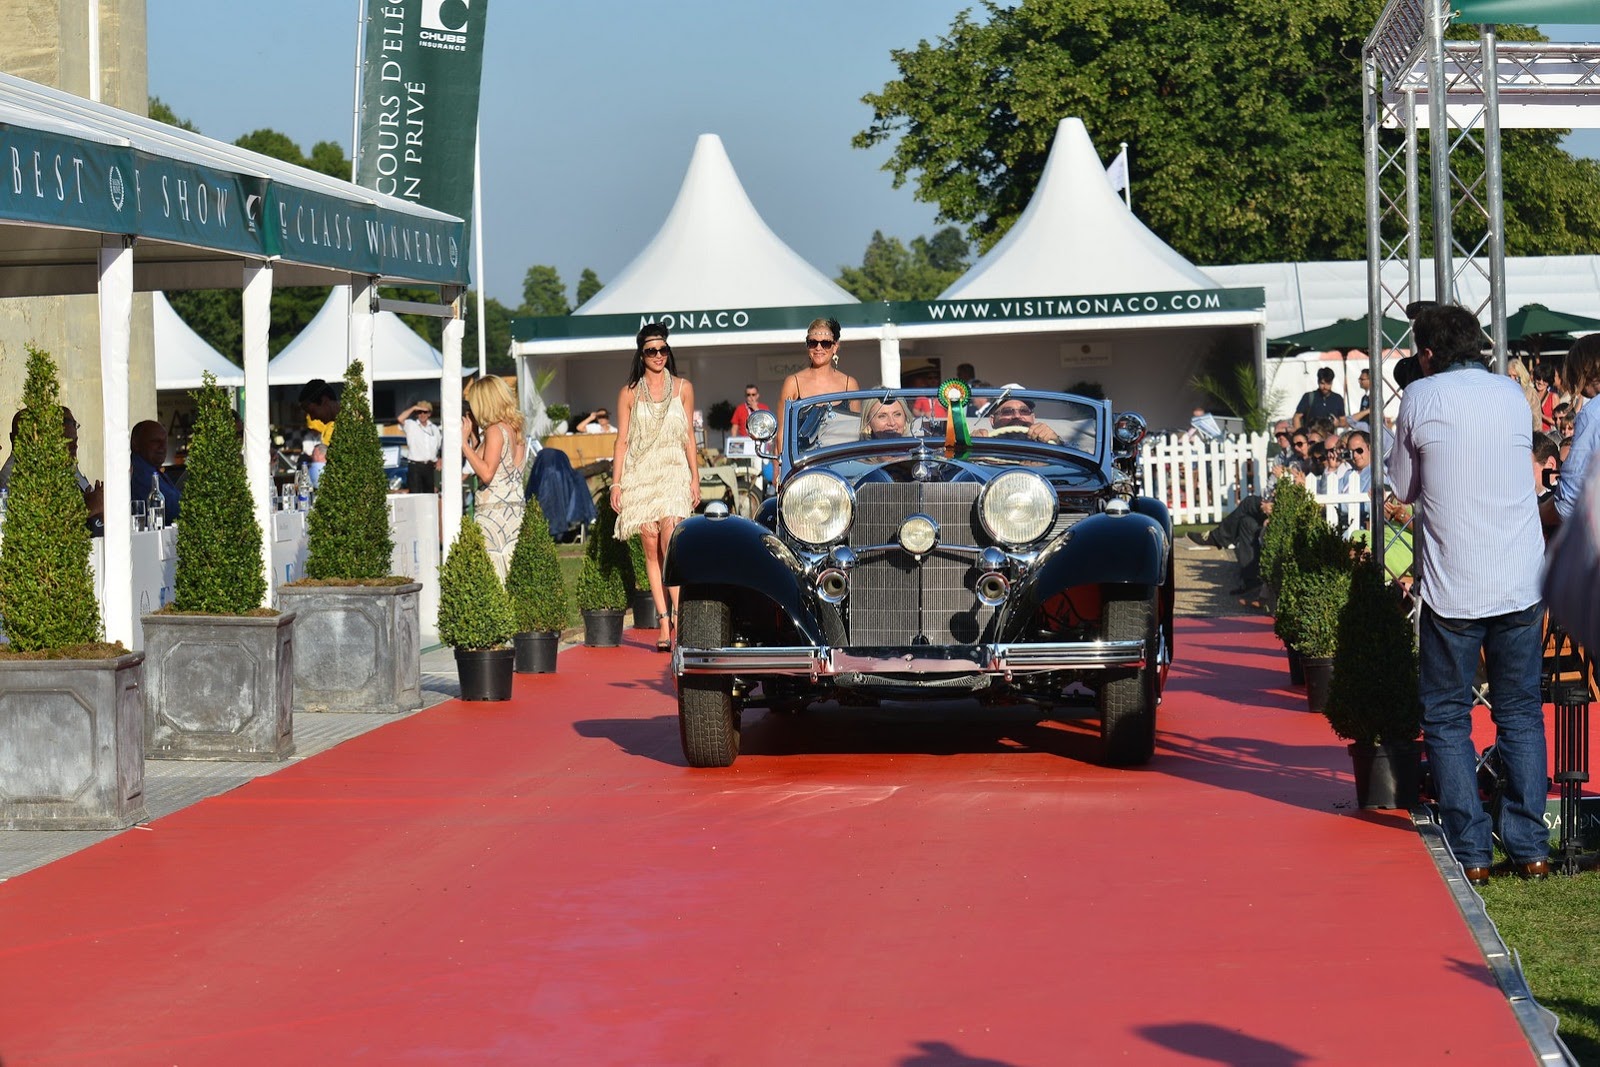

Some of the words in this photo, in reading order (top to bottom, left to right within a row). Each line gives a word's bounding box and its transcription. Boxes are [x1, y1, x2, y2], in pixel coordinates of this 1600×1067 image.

[418, 41, 467, 52] INSURANCE
[419, 31, 467, 44] CHUBB
[404, 82, 426, 164] PRIVÉ
[10, 146, 84, 204] BEST
[161, 175, 227, 228] SHOW
[297, 206, 352, 251] CLASS
[365, 220, 442, 266] WINNERS
[928, 294, 1221, 319] WWW.VISITMONACO.COM
[640, 311, 749, 330] MONACO
